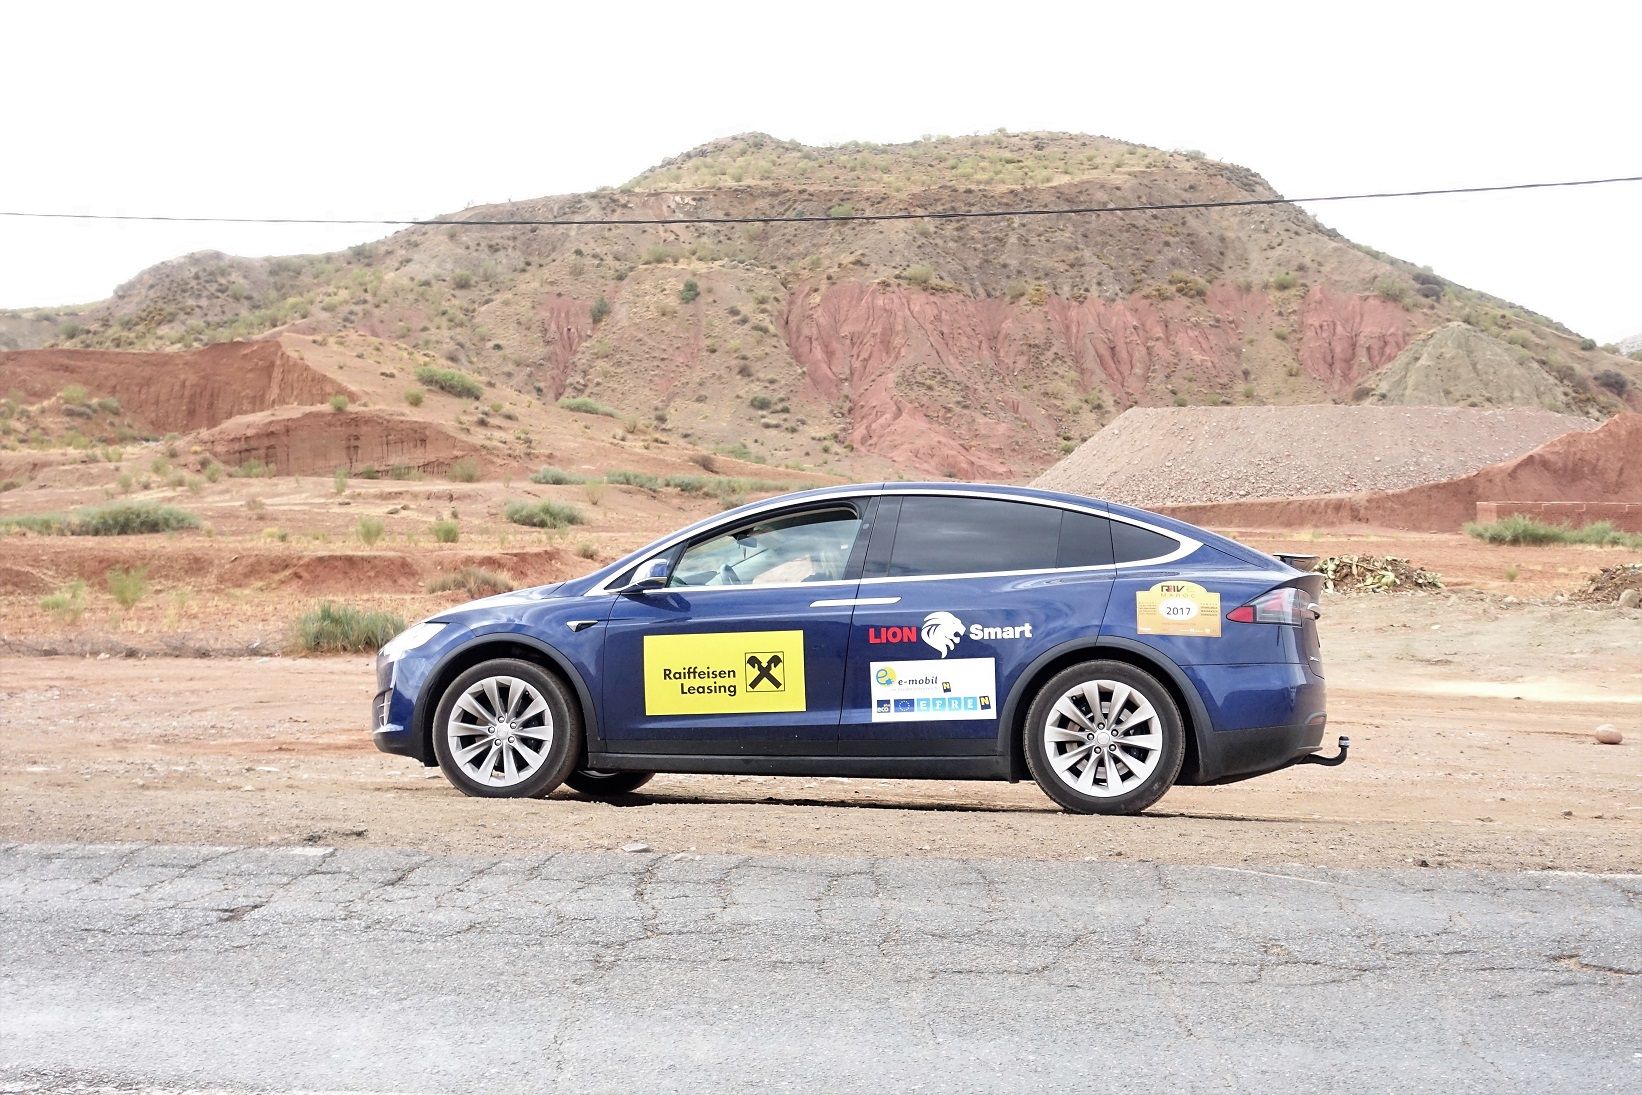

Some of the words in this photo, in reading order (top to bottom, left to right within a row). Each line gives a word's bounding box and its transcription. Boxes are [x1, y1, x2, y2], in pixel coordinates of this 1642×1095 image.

[1166, 607, 1191, 615] 2017
[868, 626, 917, 644] LION
[969, 623, 1033, 640] Smart
[663, 666, 737, 681] Raiffeisen
[898, 676, 938, 685] e-mobil
[680, 681, 737, 697] Leasing
